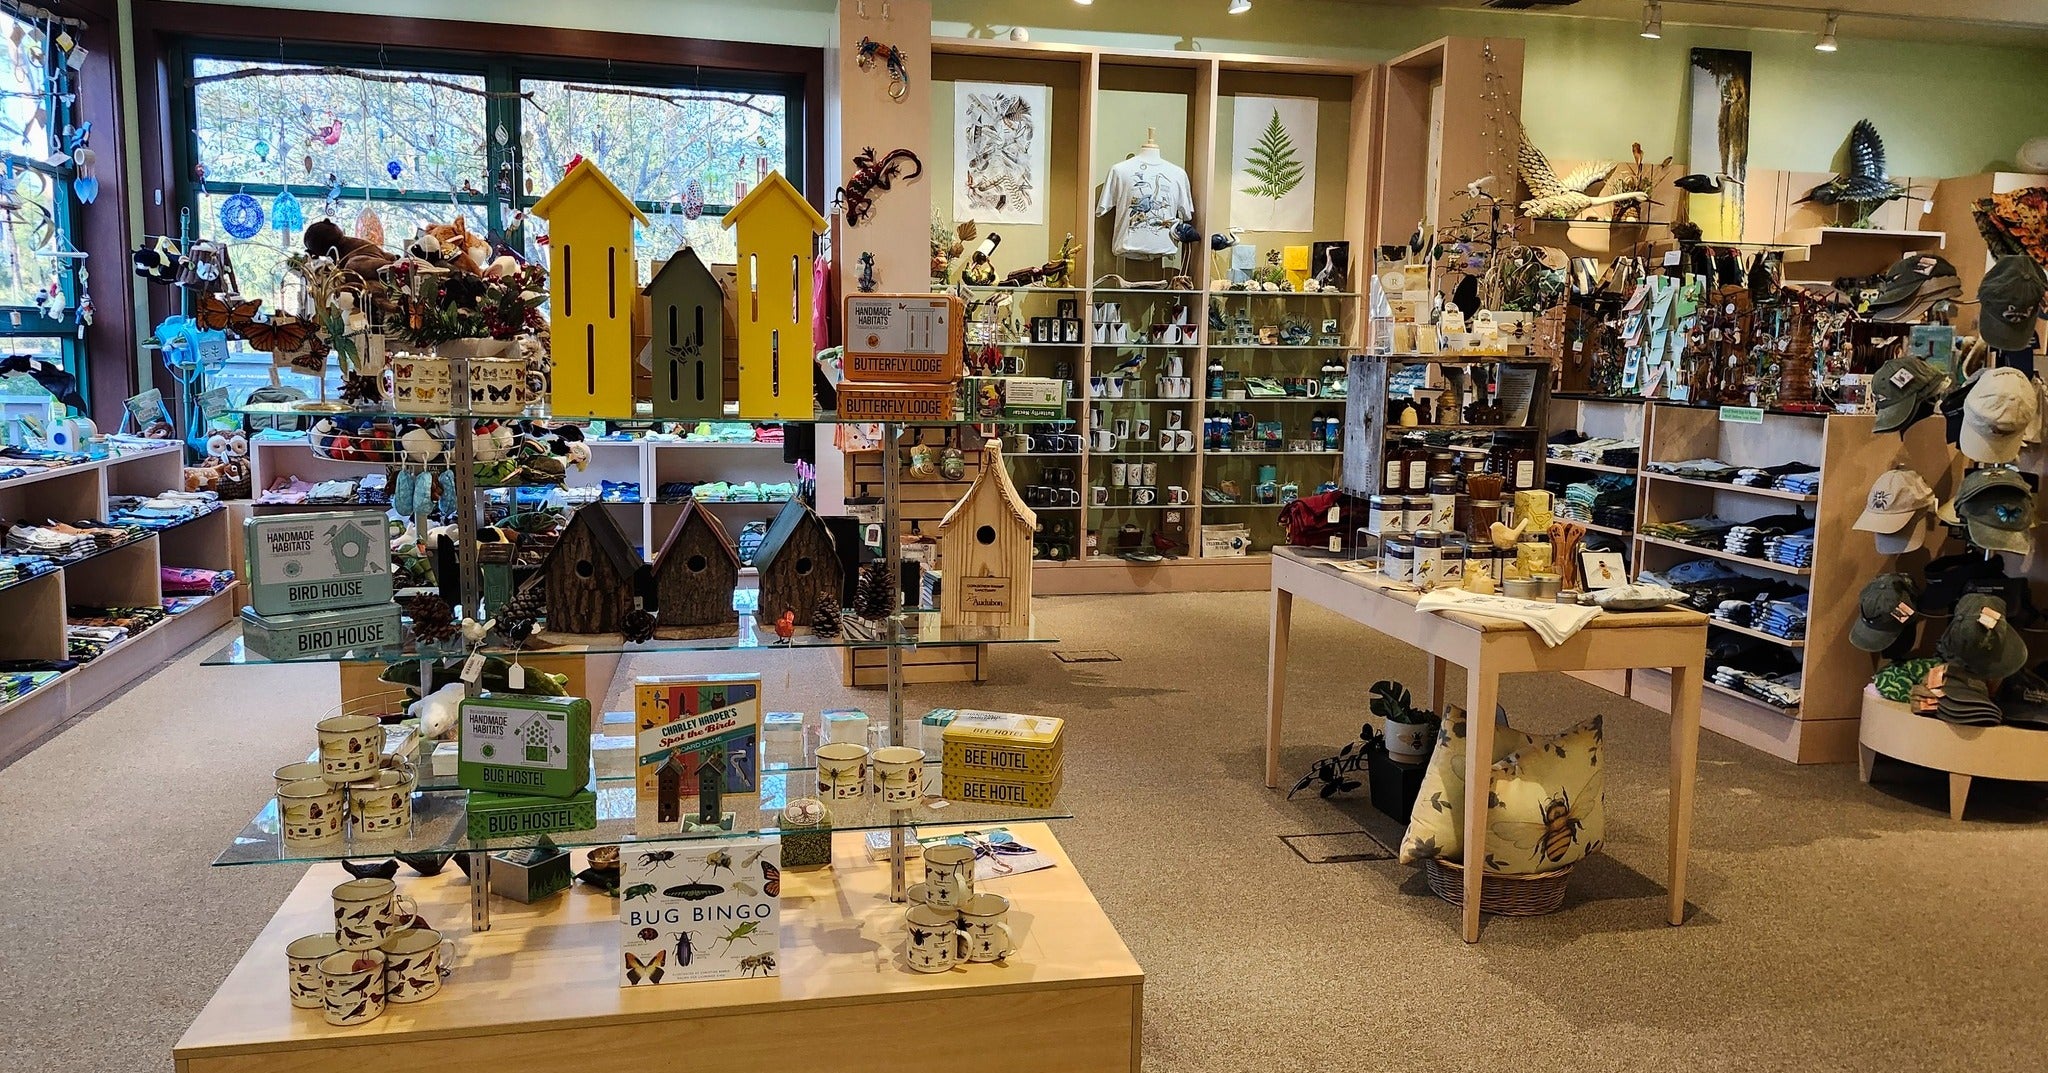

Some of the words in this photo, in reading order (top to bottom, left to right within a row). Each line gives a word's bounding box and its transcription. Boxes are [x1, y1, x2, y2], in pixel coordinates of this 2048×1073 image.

[855, 306, 892, 316] HANDMADE
[858, 316, 889, 325] HABITATS
[854, 357, 909, 372] BUTTERFLY
[910, 358, 942, 372] LODGE
[846, 398, 905, 413] BUTTERFLY
[907, 400, 942, 414] LODGE
[266, 530, 315, 543] HANDMADE
[272, 541, 311, 553] HABITATS
[289, 585, 319, 601] BIRD
[322, 581, 363, 598] HOUSE
[973, 598, 1003, 607] Audubon
[298, 631, 333, 651] BIRD
[337, 624, 384, 646] HOUSE
[469, 714, 508, 727] HANDMADE
[662, 719, 697, 737] CHARLEY
[699, 708, 738, 726] HARPER'S
[473, 724, 504, 736] HABITATS
[659, 735, 686, 748] Spot
[687, 729, 705, 739] the
[705, 719, 736, 733] Birds
[993, 729, 1024, 737] HOTEL
[702, 737, 723, 746] GAME
[965, 749, 987, 765] BEE
[990, 751, 1029, 769] HOTEL
[483, 768, 504, 783] BUG
[507, 769, 546, 786] HOSTEL
[964, 783, 986, 799] BEE
[990, 785, 1028, 801] HOTEL
[489, 816, 518, 833] BUG
[522, 810, 575, 830] HOSTEL
[630, 908, 679, 926] BUG
[693, 903, 771, 922] BINGO
